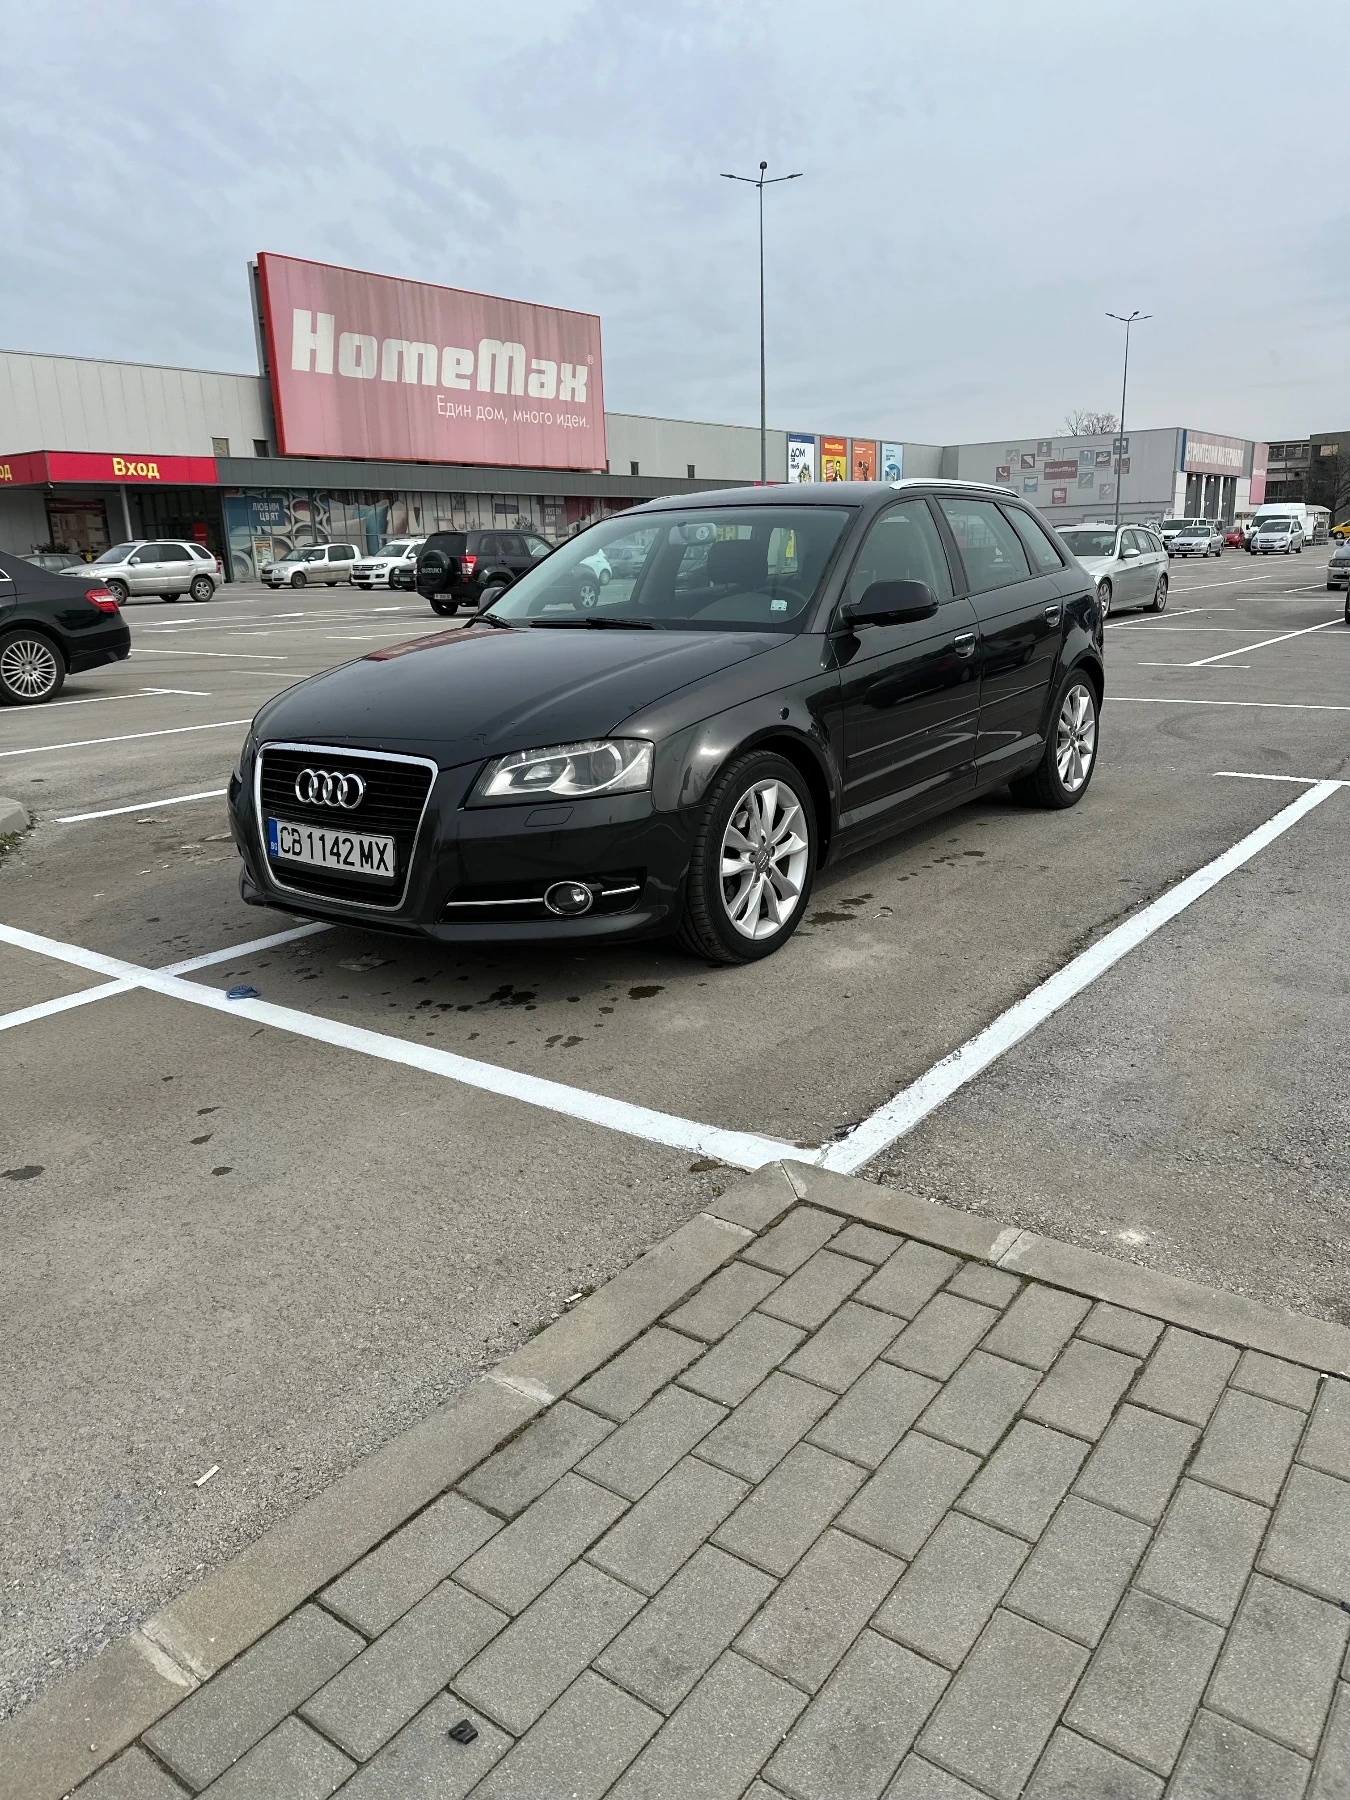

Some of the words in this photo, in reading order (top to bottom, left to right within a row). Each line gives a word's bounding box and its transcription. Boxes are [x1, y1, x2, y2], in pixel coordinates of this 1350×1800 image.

[291, 308, 588, 402] HomeMax
[437, 395, 472, 418] Един
[476, 406, 508, 425] дом,
[513, 409, 553, 425] много
[557, 413, 590, 429] идеи.
[112, 457, 160, 479] Вход
[252, 502, 280, 511] ЛЮБИМ
